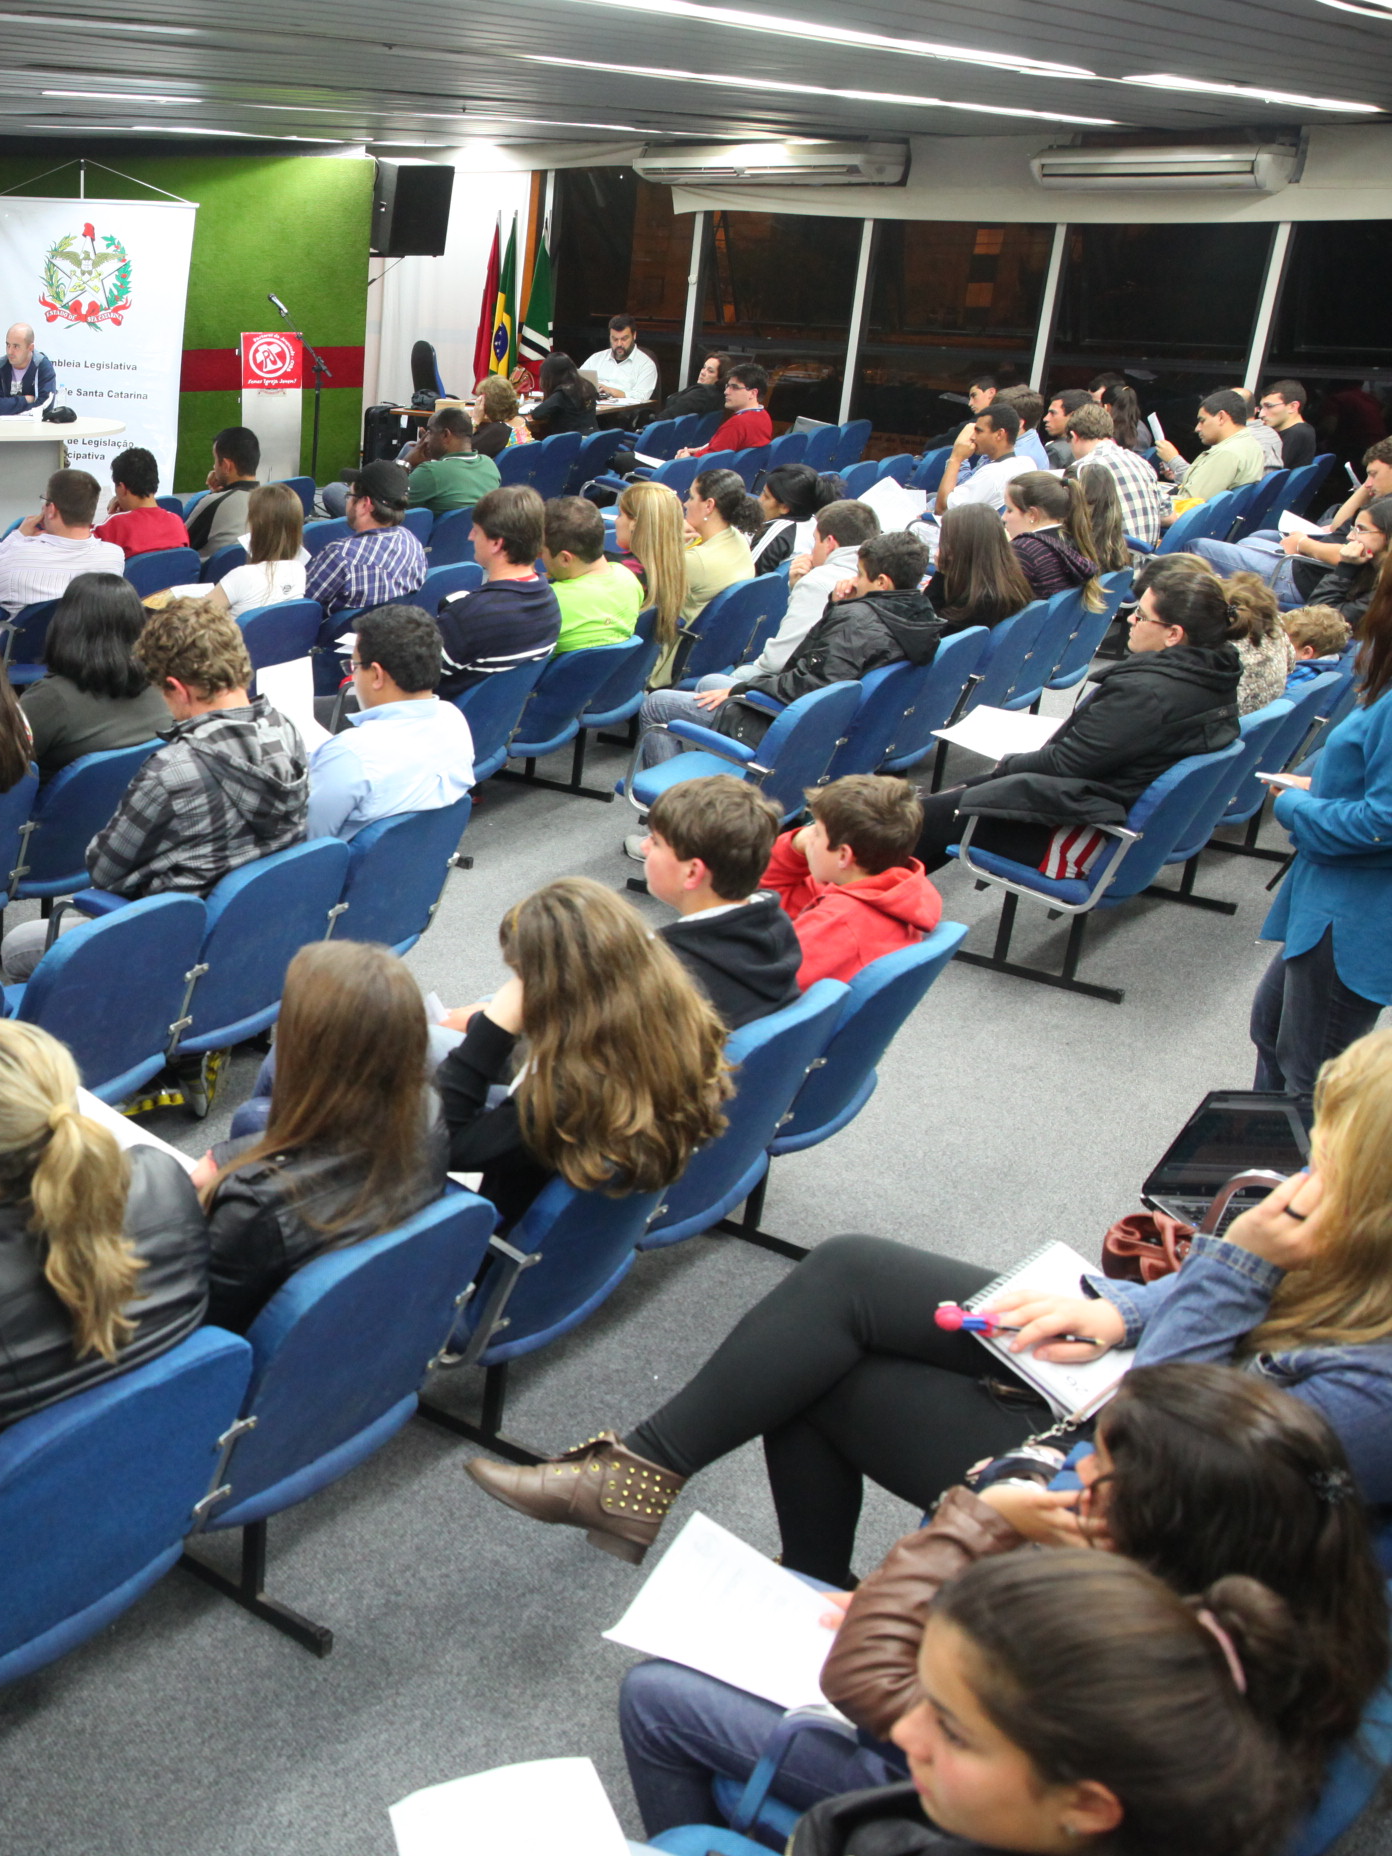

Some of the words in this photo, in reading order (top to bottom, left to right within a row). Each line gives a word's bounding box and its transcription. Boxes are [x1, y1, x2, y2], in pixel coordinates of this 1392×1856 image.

[50, 359, 81, 369] mbleia
[84, 360, 137, 371] Legislativa
[76, 388, 104, 398] Santa
[107, 389, 148, 400] Catarina
[67, 451, 106, 461] cipativa
